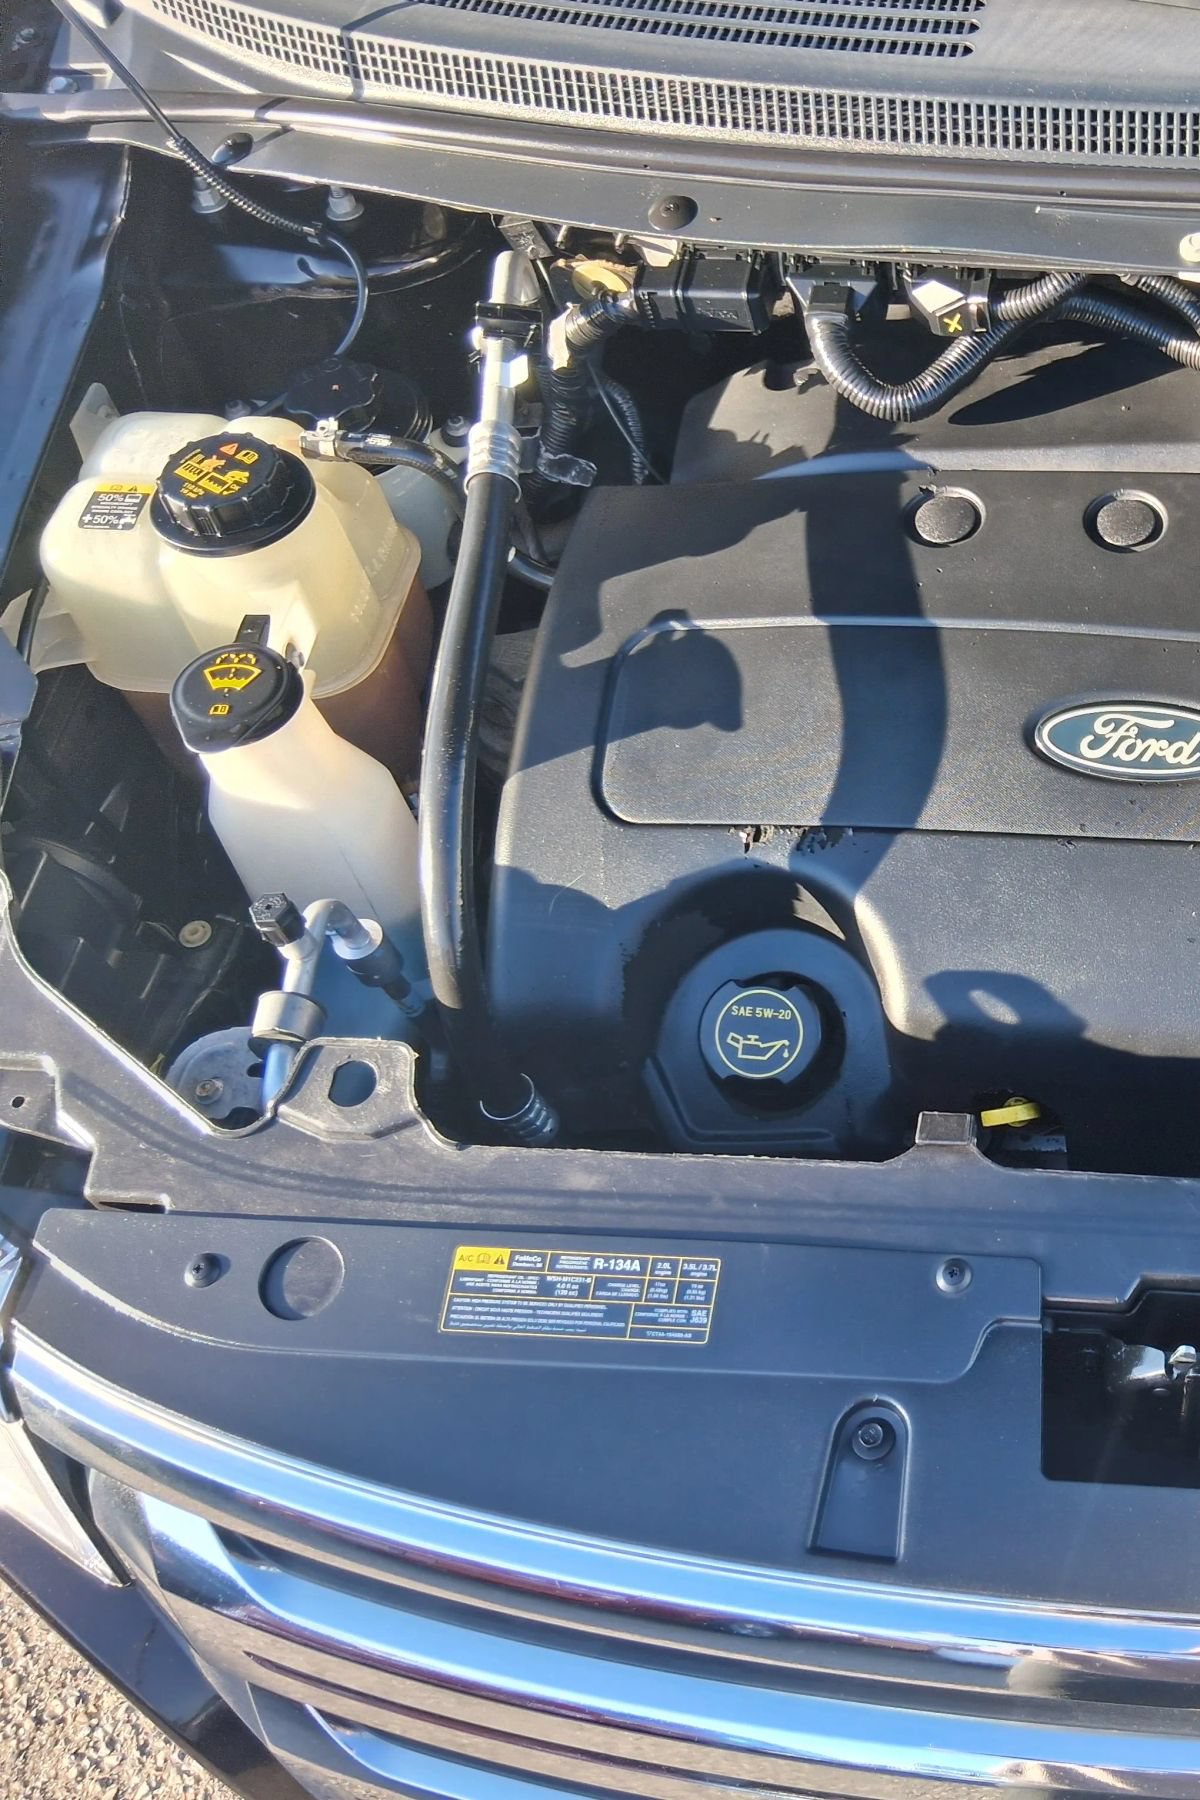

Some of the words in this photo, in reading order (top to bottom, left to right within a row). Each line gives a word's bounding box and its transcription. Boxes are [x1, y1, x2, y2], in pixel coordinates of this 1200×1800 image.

[97, 494, 124, 502] 50%
[731, 1005, 753, 1017] SAE
[755, 1008, 792, 1020] 5W-20
[458, 1253, 475, 1262] A/C
[515, 1254, 542, 1262] FoMoCo
[593, 1259, 641, 1272] R-134A
[656, 1262, 672, 1270] 2.0L
[689, 1316, 708, 1324] J639
